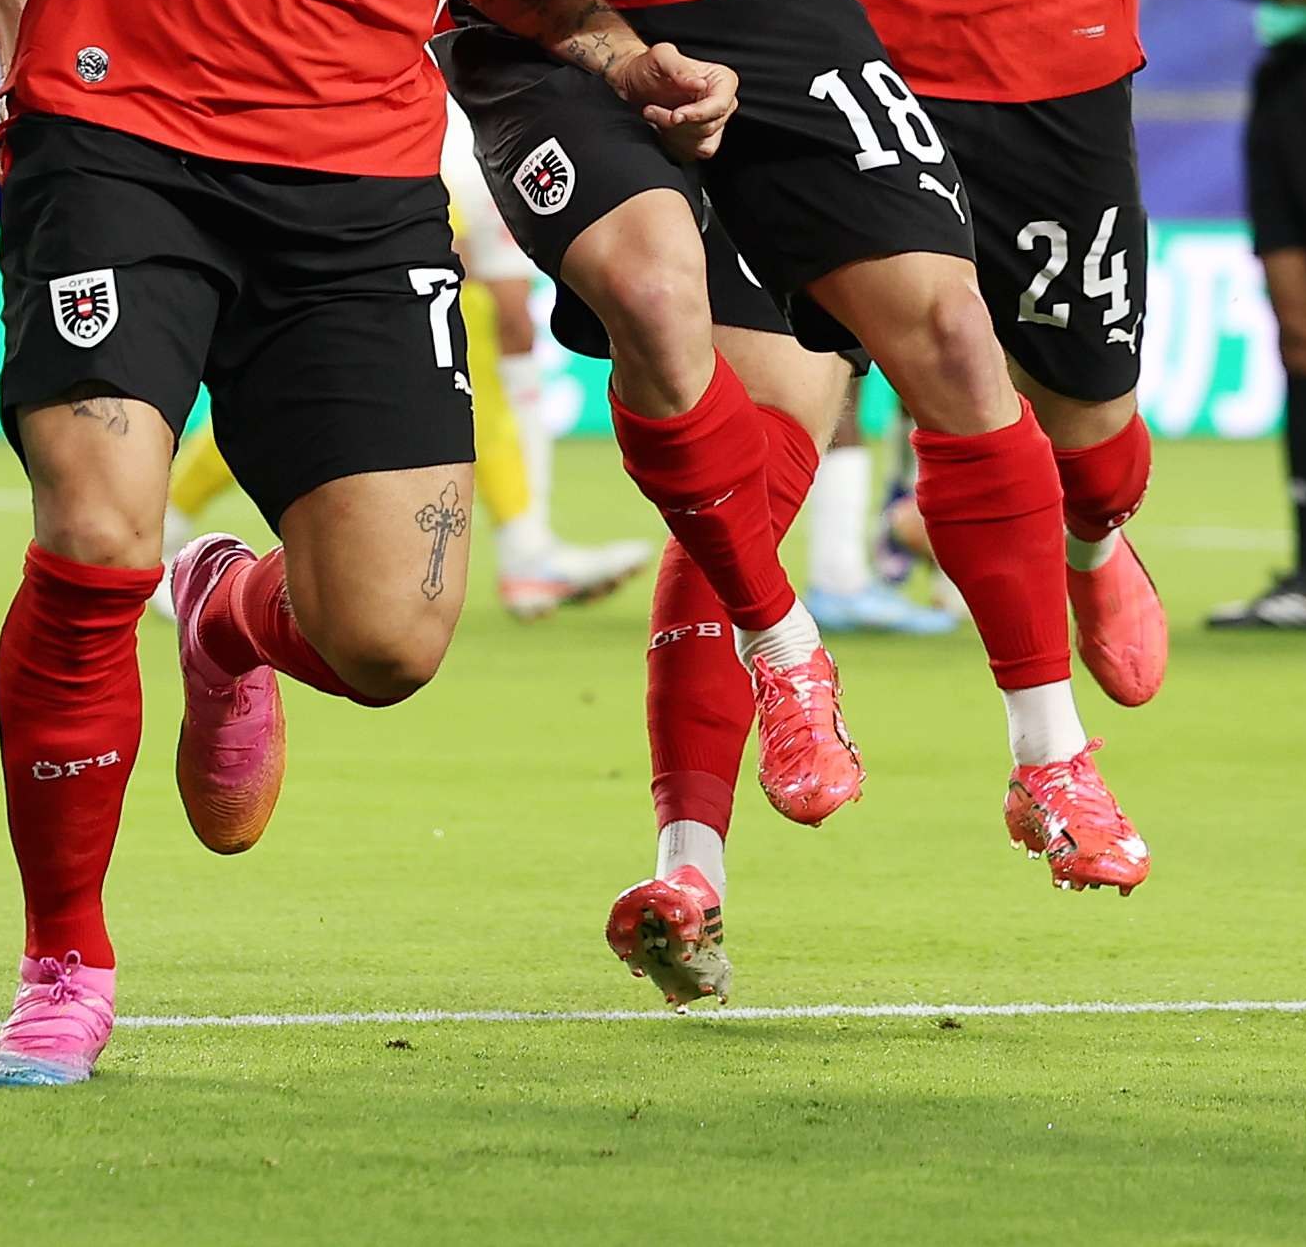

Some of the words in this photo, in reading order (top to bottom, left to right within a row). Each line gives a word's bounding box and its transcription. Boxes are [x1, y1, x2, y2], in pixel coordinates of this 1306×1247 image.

[809, 60, 946, 171] 18
[408, 268, 465, 368] 7
[1016, 206, 1131, 328] 24
[32, 750, 121, 781] ÖFB
